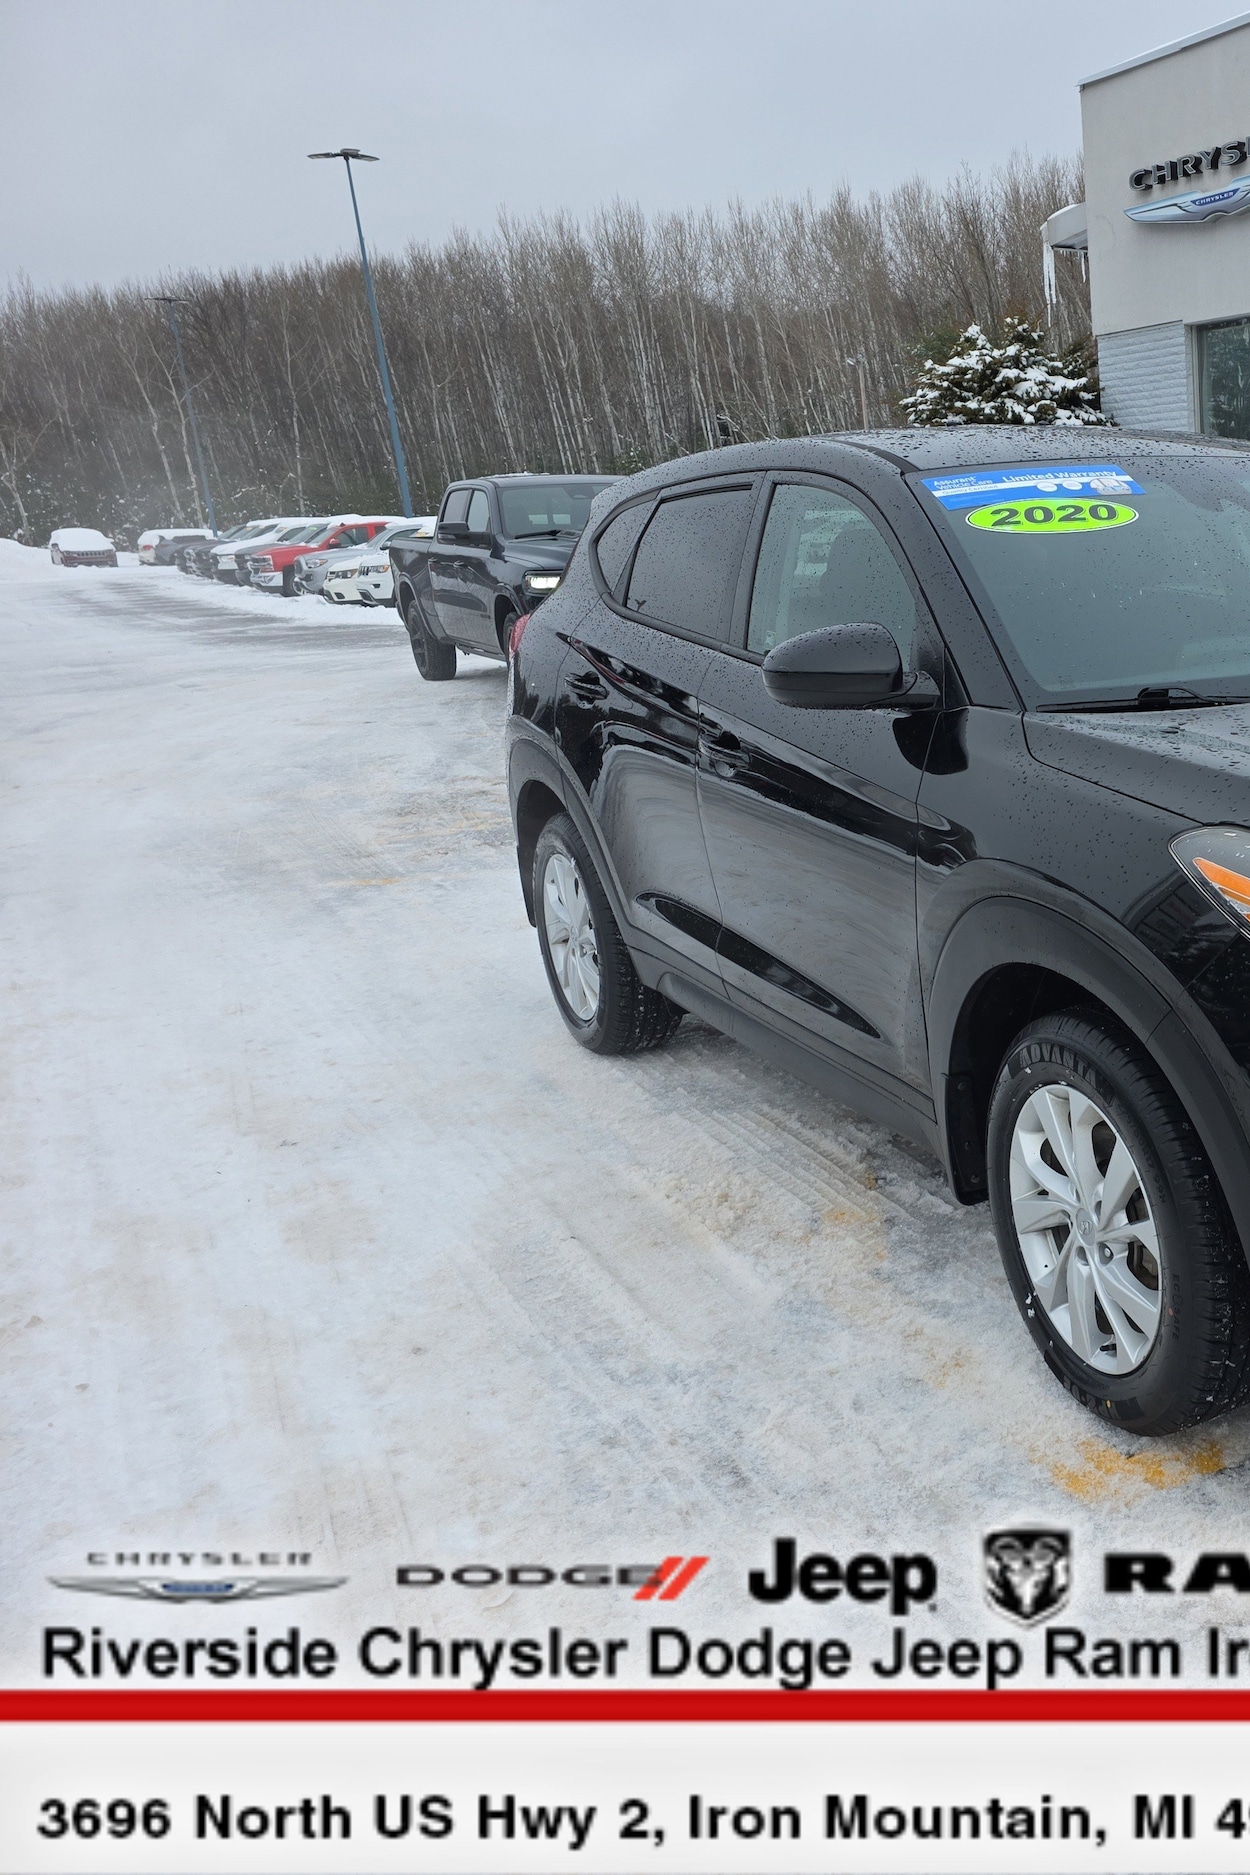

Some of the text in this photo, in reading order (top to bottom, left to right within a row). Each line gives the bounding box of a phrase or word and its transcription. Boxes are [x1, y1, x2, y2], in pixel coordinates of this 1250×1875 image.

[1195, 190, 1235, 206] CHRYSLER
[1002, 470, 1117, 483] Limited Warranty
[990, 504, 1119, 528] 2020
[1018, 1042, 1097, 1089] ADVANTA
